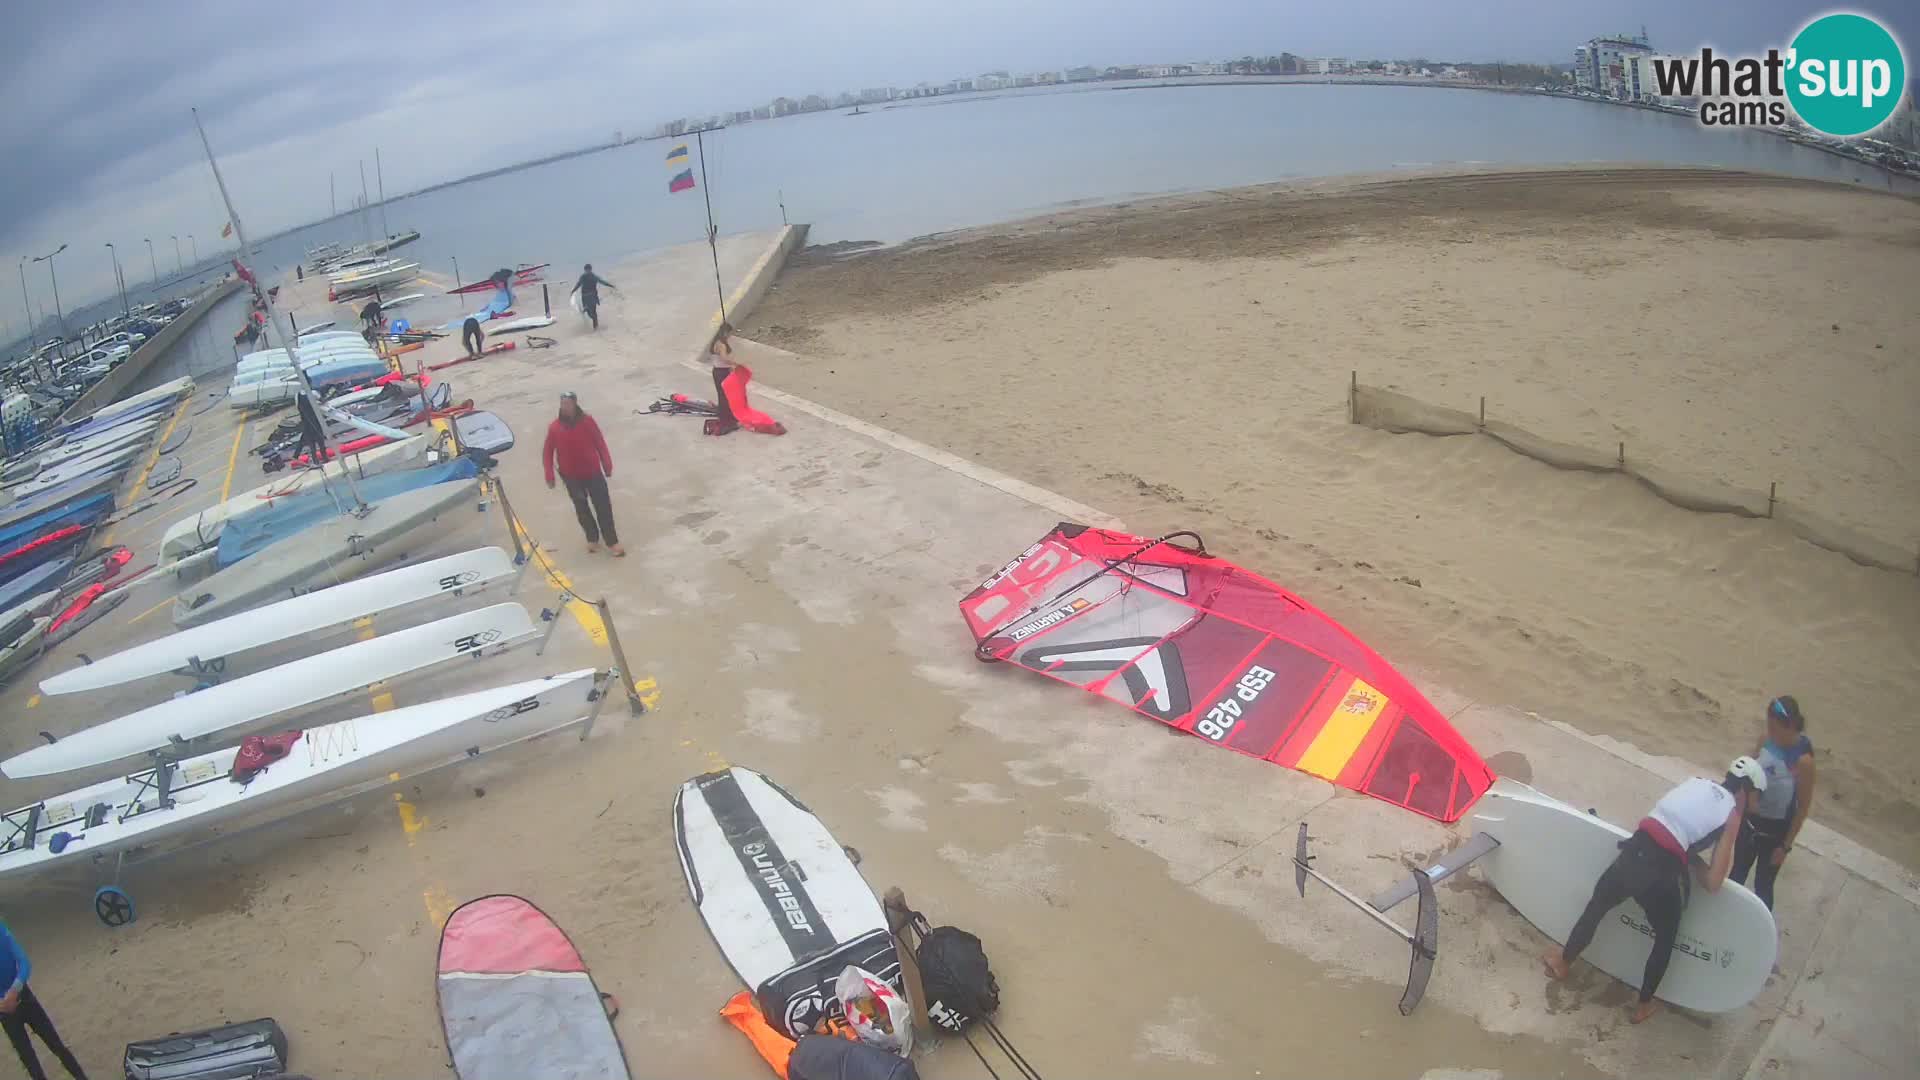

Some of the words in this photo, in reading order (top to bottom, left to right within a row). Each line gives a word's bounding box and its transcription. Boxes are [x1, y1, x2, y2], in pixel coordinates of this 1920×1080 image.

[983, 543, 1043, 590] SEVERNE
[1011, 610, 1065, 640] MARTINEZ
[1236, 665, 1276, 702] ESP
[1198, 698, 1242, 740] 426
